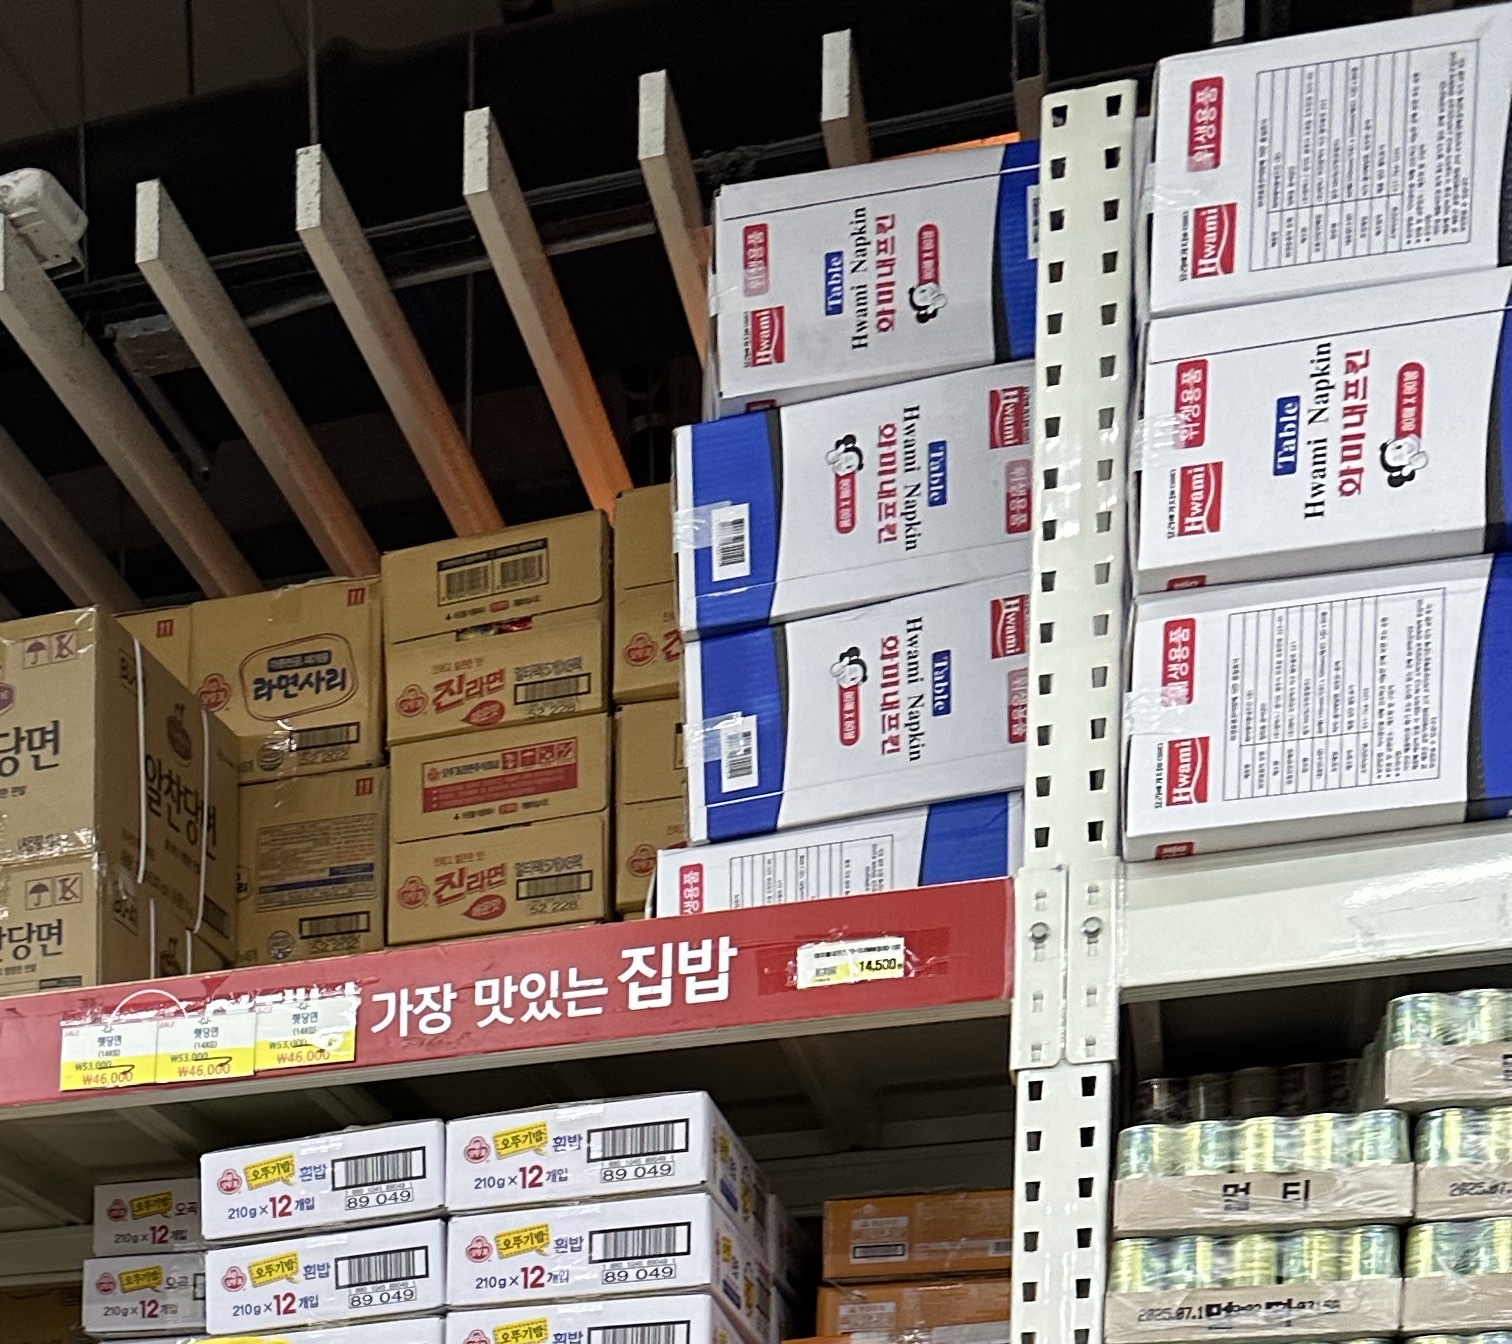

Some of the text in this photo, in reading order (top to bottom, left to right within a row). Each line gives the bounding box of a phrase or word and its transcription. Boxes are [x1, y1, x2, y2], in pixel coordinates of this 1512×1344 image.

[1196, 208, 1219, 274] Hwami
[827, 254, 842, 312] Table
[851, 207, 871, 350] Hwami Napkin
[757, 310, 773, 365] Hwami
[1277, 402, 1298, 470] Table
[1304, 342, 1335, 519] Hwami Napkin
[1338, 349, 1370, 497] 화미내프킨
[901, 405, 921, 551] Hwami Napkin
[929, 450, 946, 503] Table
[1184, 466, 1206, 532] Hwami
[253, 668, 347, 701] 라면사리
[432, 668, 506, 714] 진라면
[906, 615, 923, 762] Hwami Napkin
[432, 862, 508, 907] 진라면
[371, 935, 736, 1039] 가장 맛있는 집밥
[501, 1132, 582, 1152] 오뚜기밥 흰밥
[248, 1160, 327, 1185] 오뚜기밥 흰밥
[346, 1189, 413, 1208] 89 049
[603, 1164, 672, 1181] 89 049
[502, 1232, 584, 1253] 오뚜기밥 흰밥
[604, 1267, 674, 1284] 89 049
